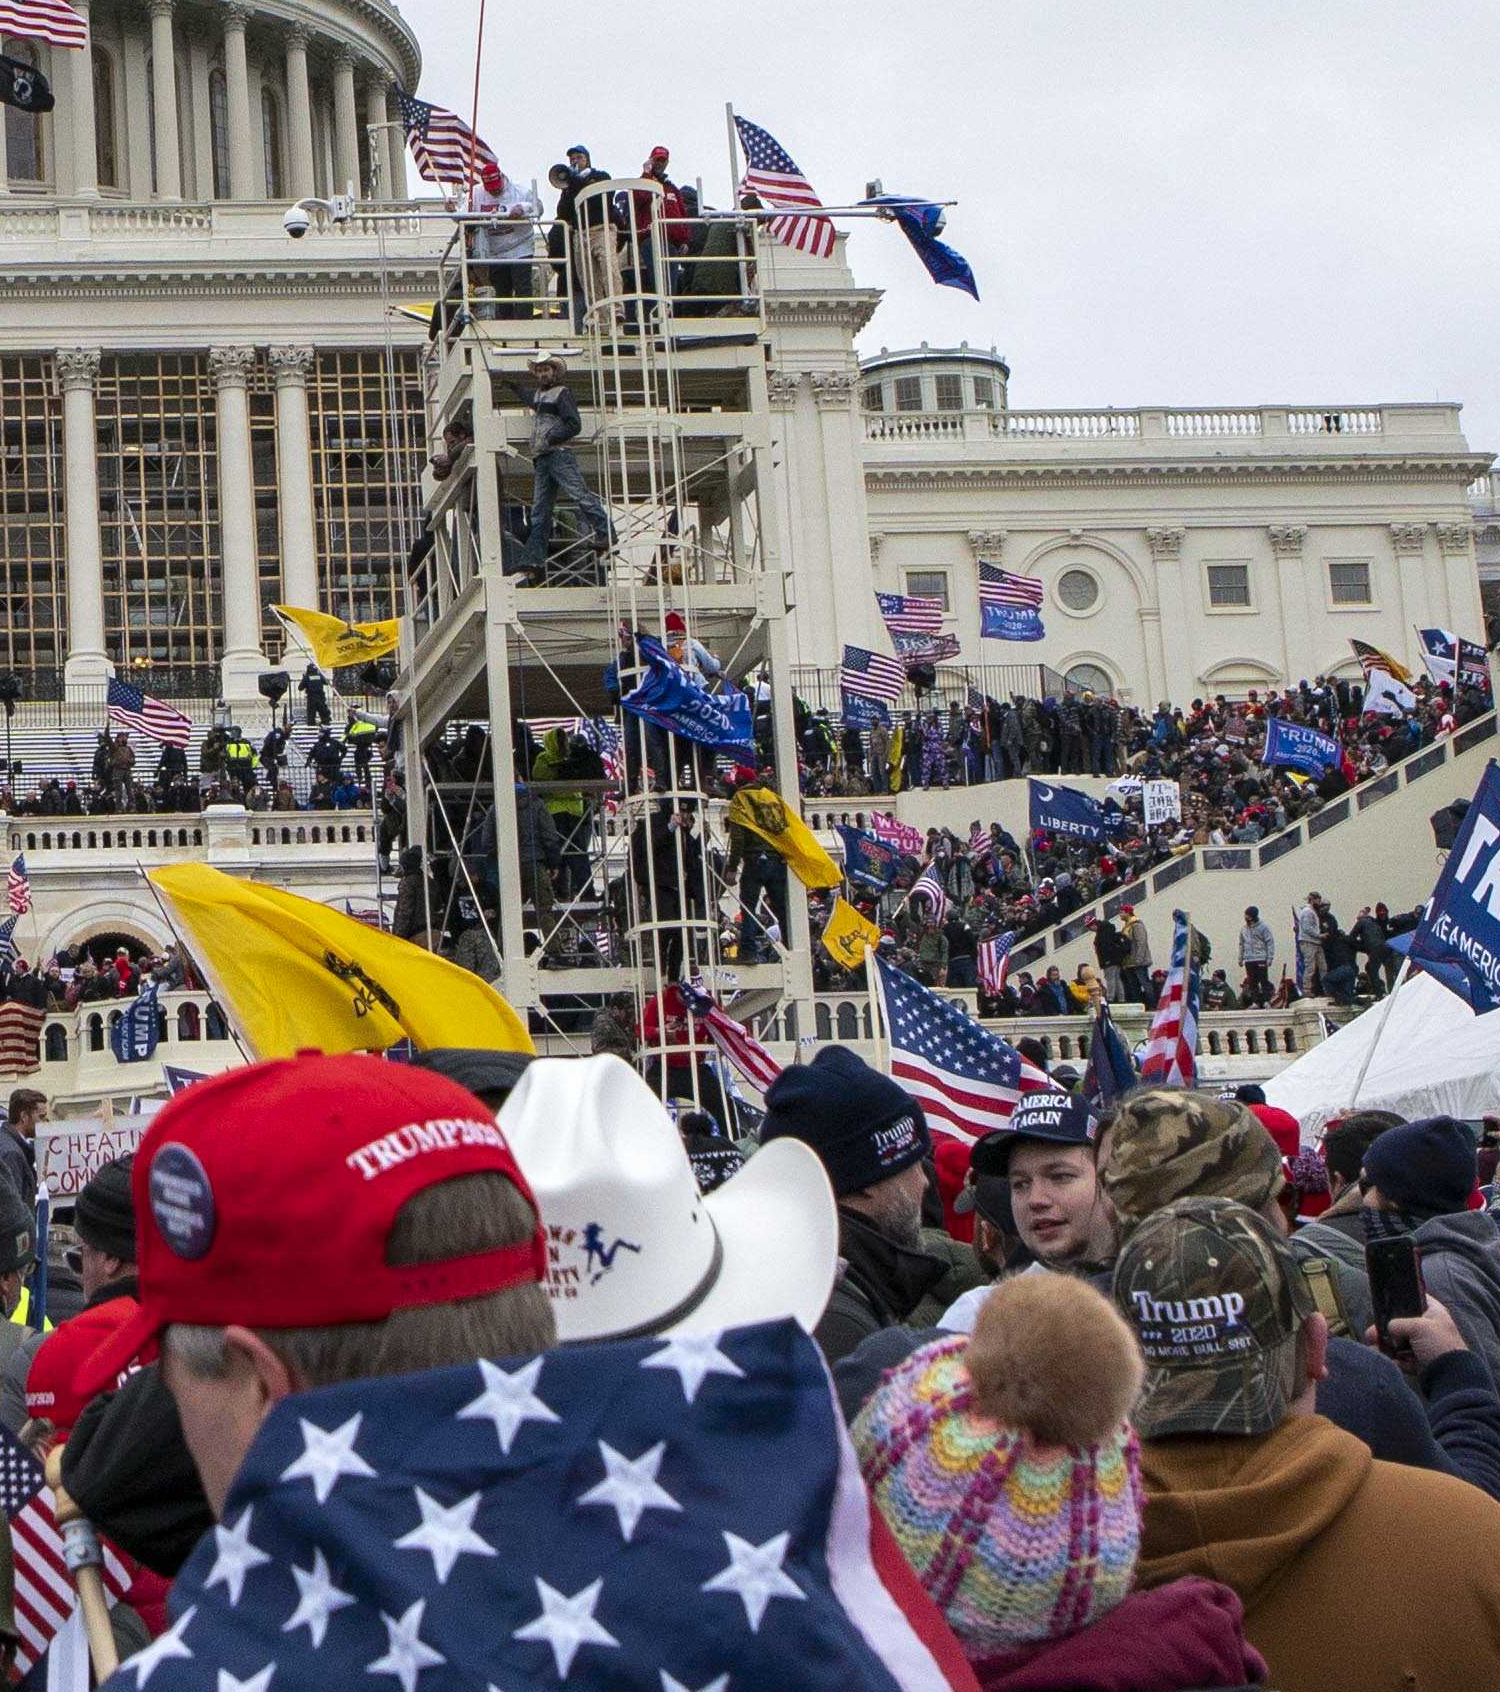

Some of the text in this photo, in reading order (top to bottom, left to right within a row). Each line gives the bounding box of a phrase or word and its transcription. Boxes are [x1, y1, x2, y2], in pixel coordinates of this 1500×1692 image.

[987, 606, 1036, 621] TRUMP
[1280, 727, 1337, 756] TRUMP
[1039, 815, 1099, 837] LIBERTY
[134, 991, 150, 1057] RUMP
[872, 1116, 914, 1149] Trump
[1026, 1111, 1063, 1130] AGAIN
[48, 1130, 146, 1156] CHEATI
[68, 1150, 132, 1170] LYIN
[1129, 1291, 1244, 1328] Trump
[1171, 1326, 1214, 1344] 2020
